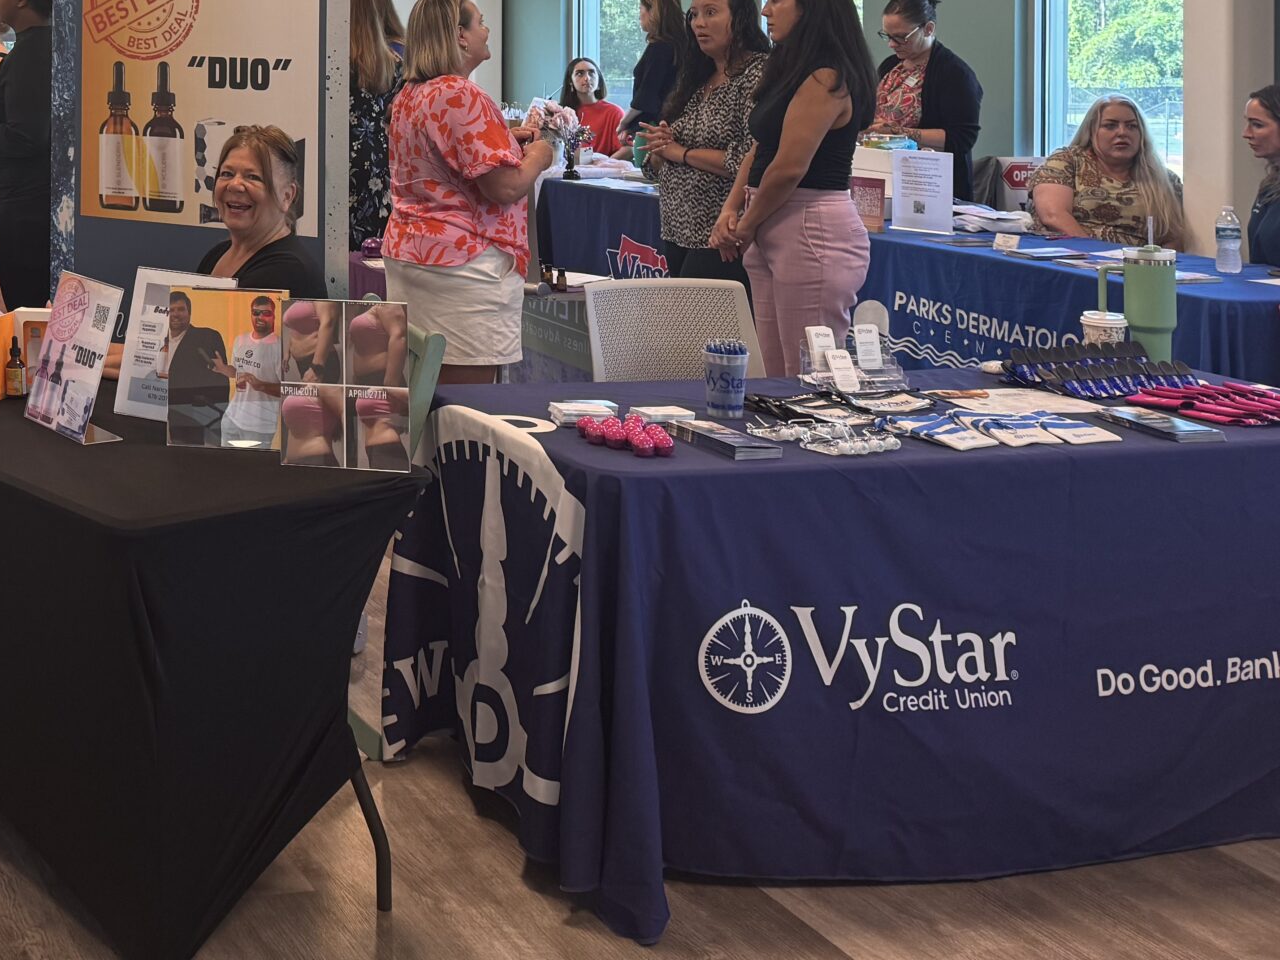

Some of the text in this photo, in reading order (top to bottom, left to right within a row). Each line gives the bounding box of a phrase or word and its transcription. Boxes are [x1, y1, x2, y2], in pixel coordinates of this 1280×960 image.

[127, 8, 189, 51] BEST DEAL
[67, 296, 89, 314] DEAL
[894, 290, 1084, 349] PARKS DERMATOLO
[281, 386, 318, 397] APRIL 20TH
[348, 389, 387, 400] APRIL 27TH
[1095, 666, 1135, 698] Do
[1138, 658, 1222, 693] Good.
[882, 684, 1013, 714] Credit Union
